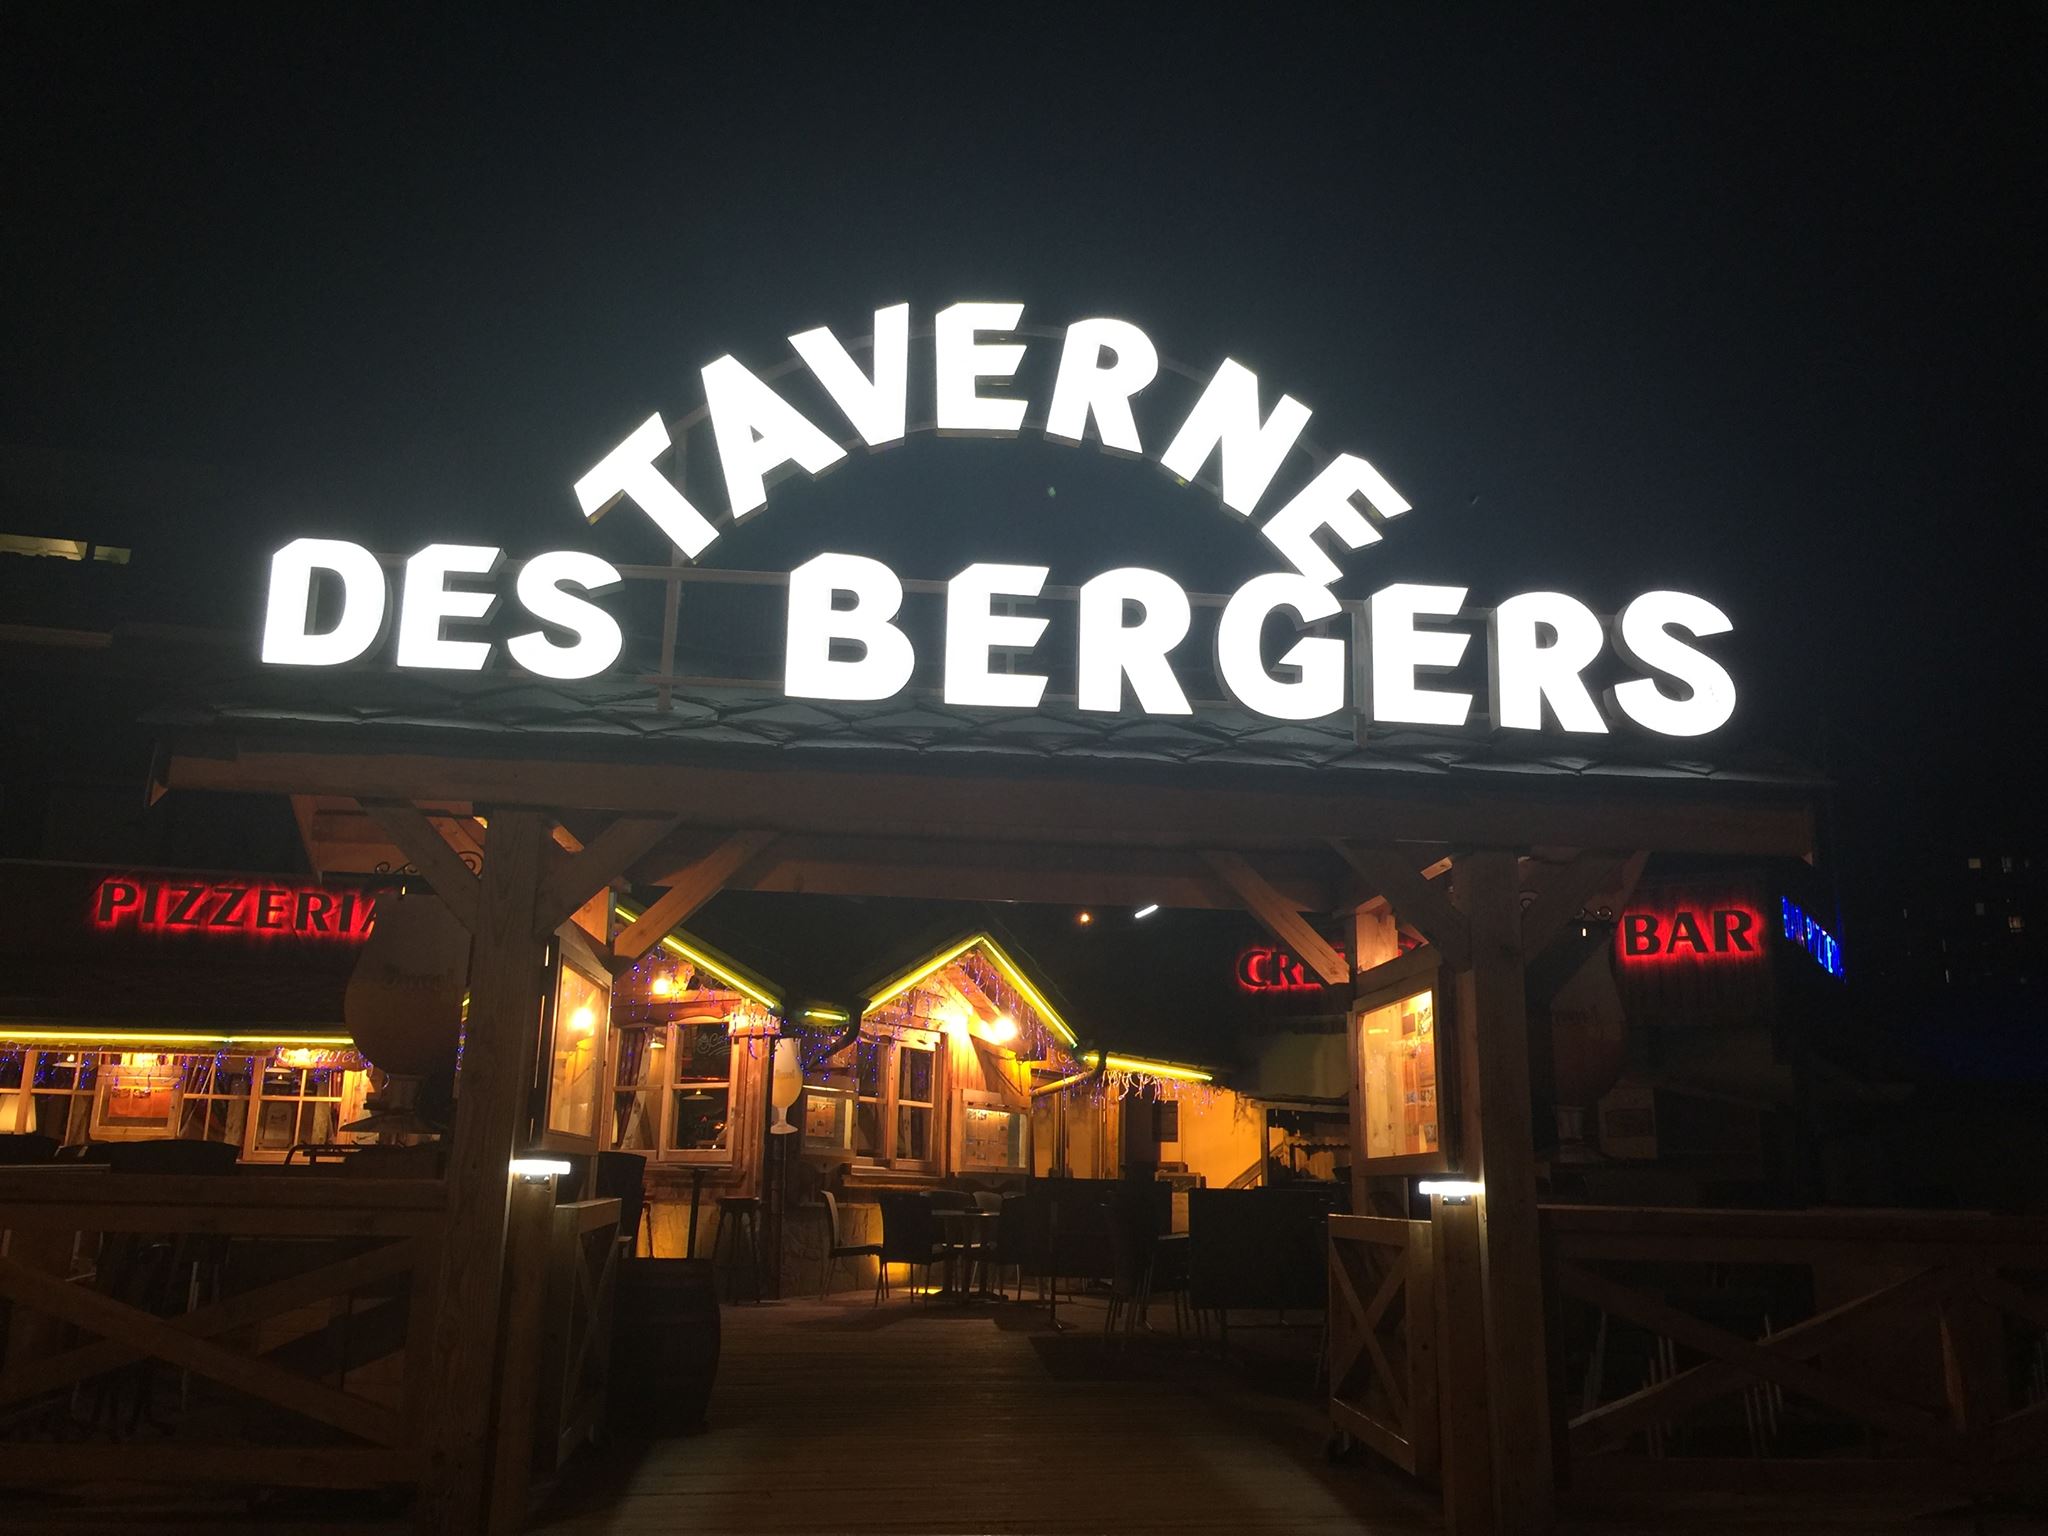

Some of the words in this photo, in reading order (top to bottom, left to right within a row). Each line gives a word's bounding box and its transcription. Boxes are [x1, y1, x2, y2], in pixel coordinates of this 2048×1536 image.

[573, 301, 1413, 585] TAVERNE
[261, 537, 626, 681] DES
[783, 551, 1737, 738] BERGERS
[1623, 909, 1755, 957] BAR
